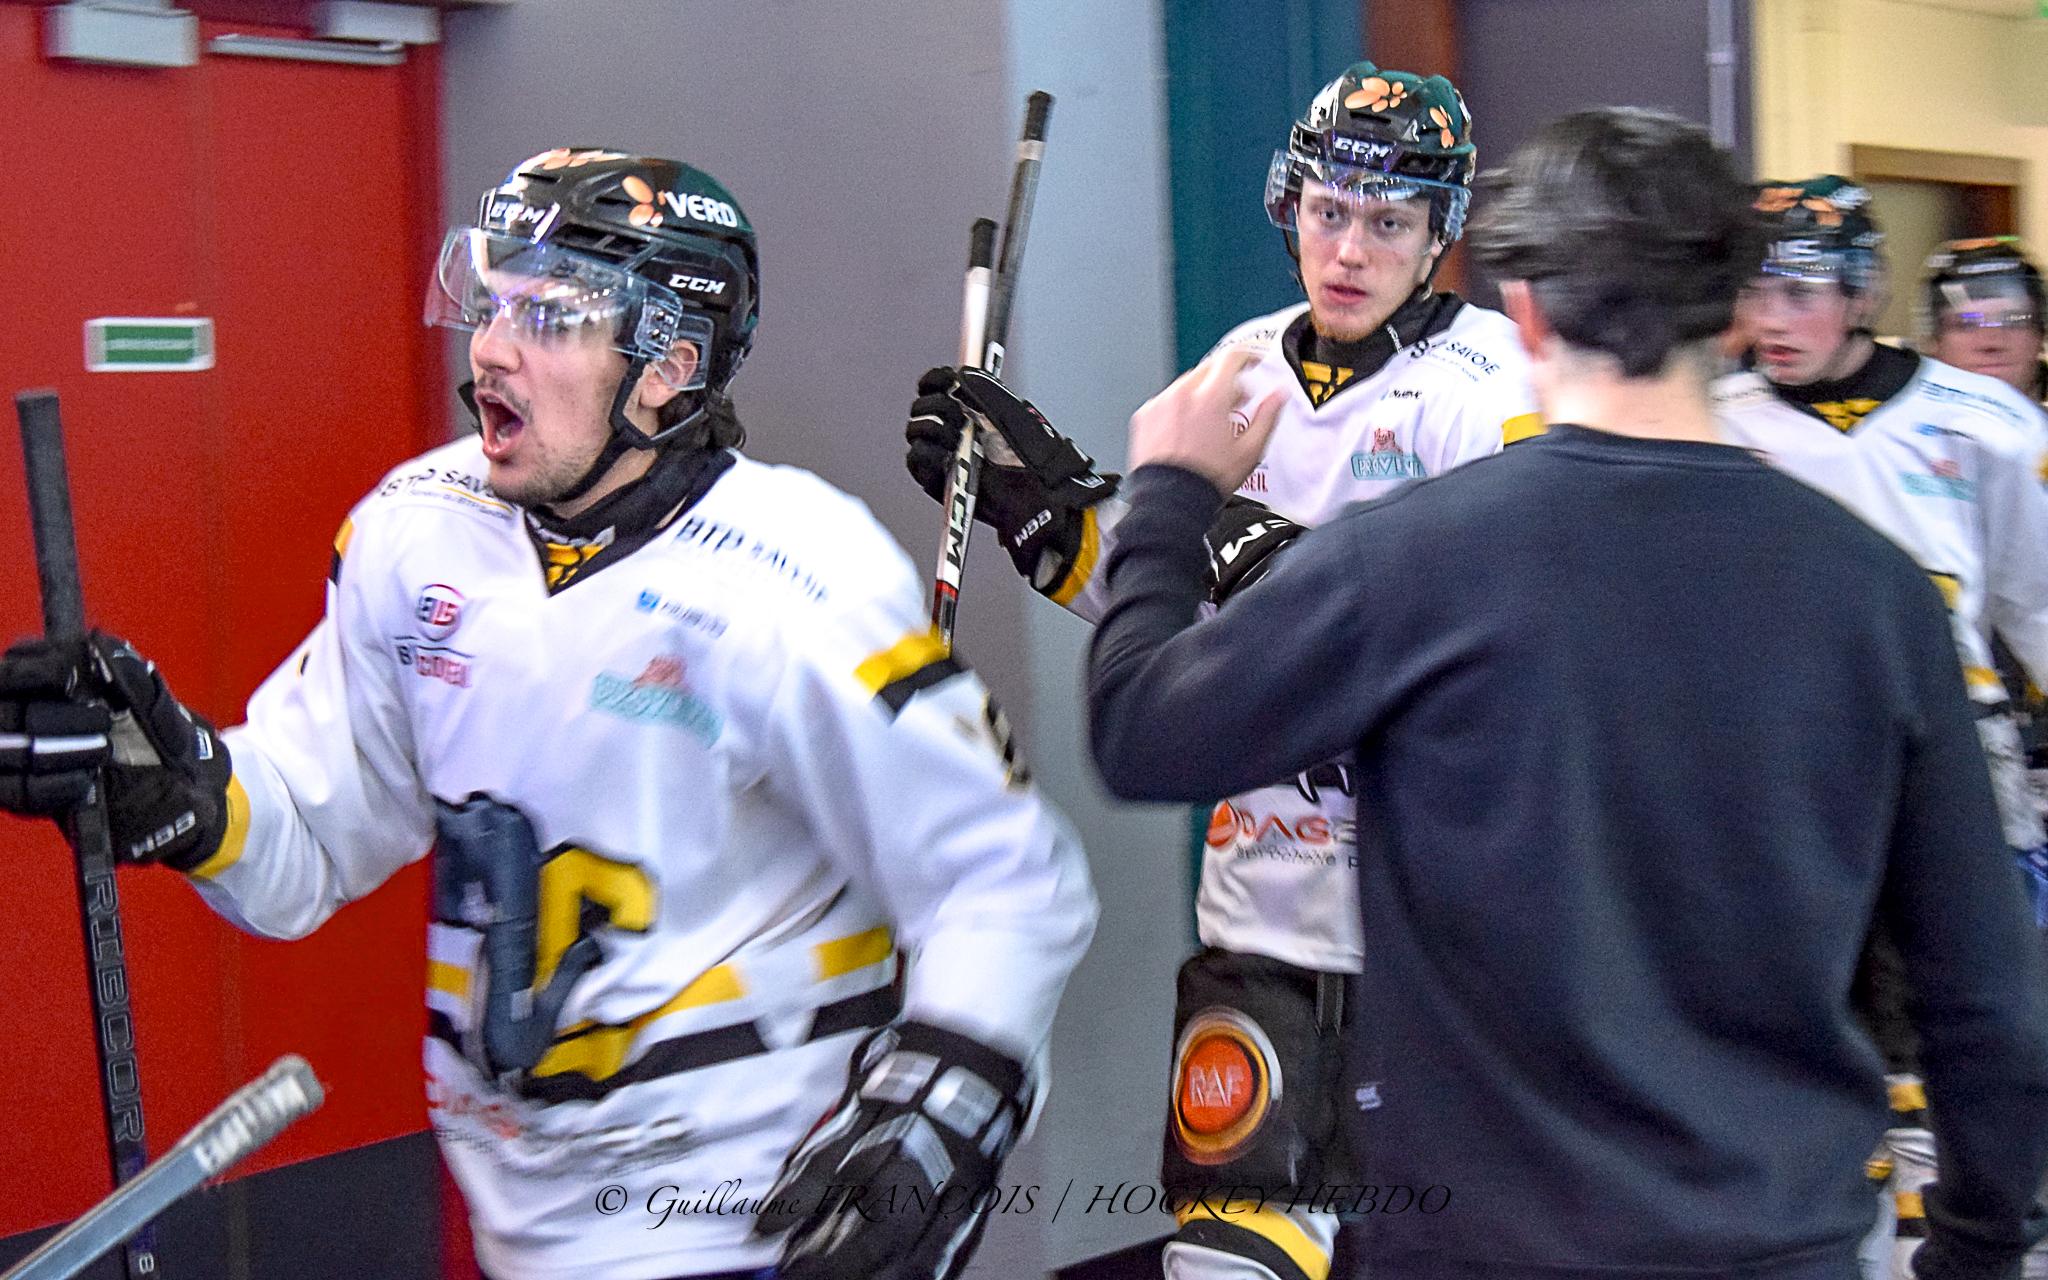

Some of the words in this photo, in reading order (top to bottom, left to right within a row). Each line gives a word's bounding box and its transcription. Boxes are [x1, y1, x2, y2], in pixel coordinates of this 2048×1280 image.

[1335, 137, 1390, 158] CCM
[668, 273, 727, 295] CCM
[1446, 341, 1501, 376] SAVOIE
[85, 867, 146, 1144] RIBCOR
